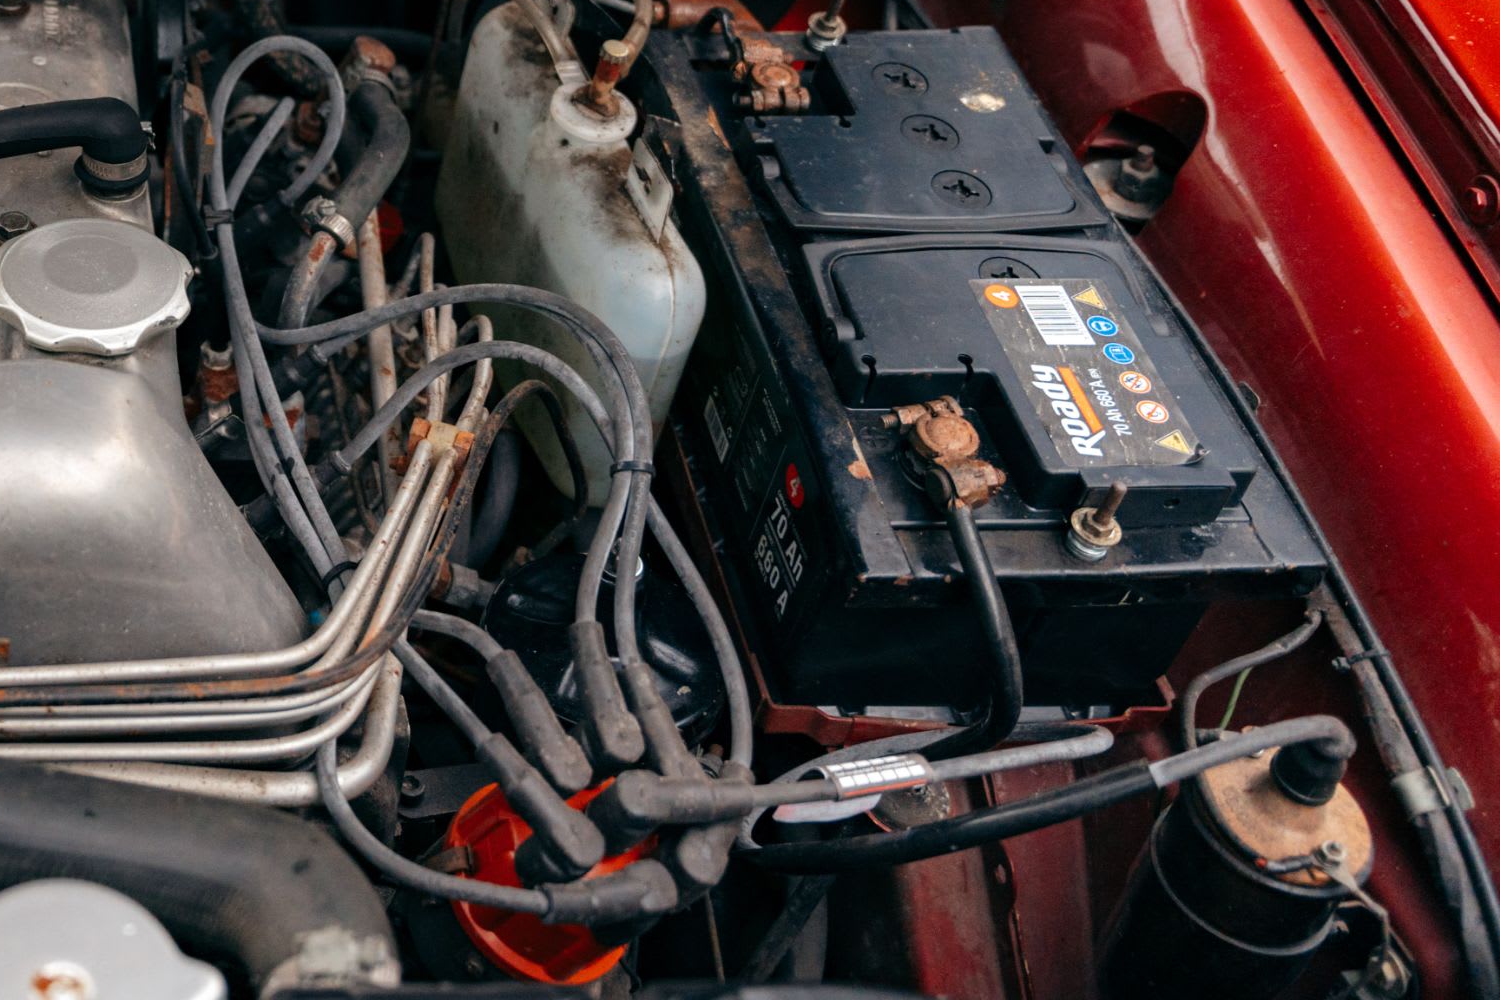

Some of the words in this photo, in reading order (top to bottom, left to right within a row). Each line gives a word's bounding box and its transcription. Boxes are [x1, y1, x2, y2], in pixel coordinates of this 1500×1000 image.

[991, 290, 1011, 302] 4
[1088, 379, 1106, 389] A
[1093, 389, 1116, 407] 660
[1030, 364, 1106, 457] Roady
[1104, 408, 1126, 423] Ah
[1112, 423, 1133, 437] 70
[791, 477, 799, 498] 4
[770, 496, 788, 540] 70
[785, 540, 804, 582] Ah
[757, 534, 781, 590] 660
[776, 589, 789, 616] A
